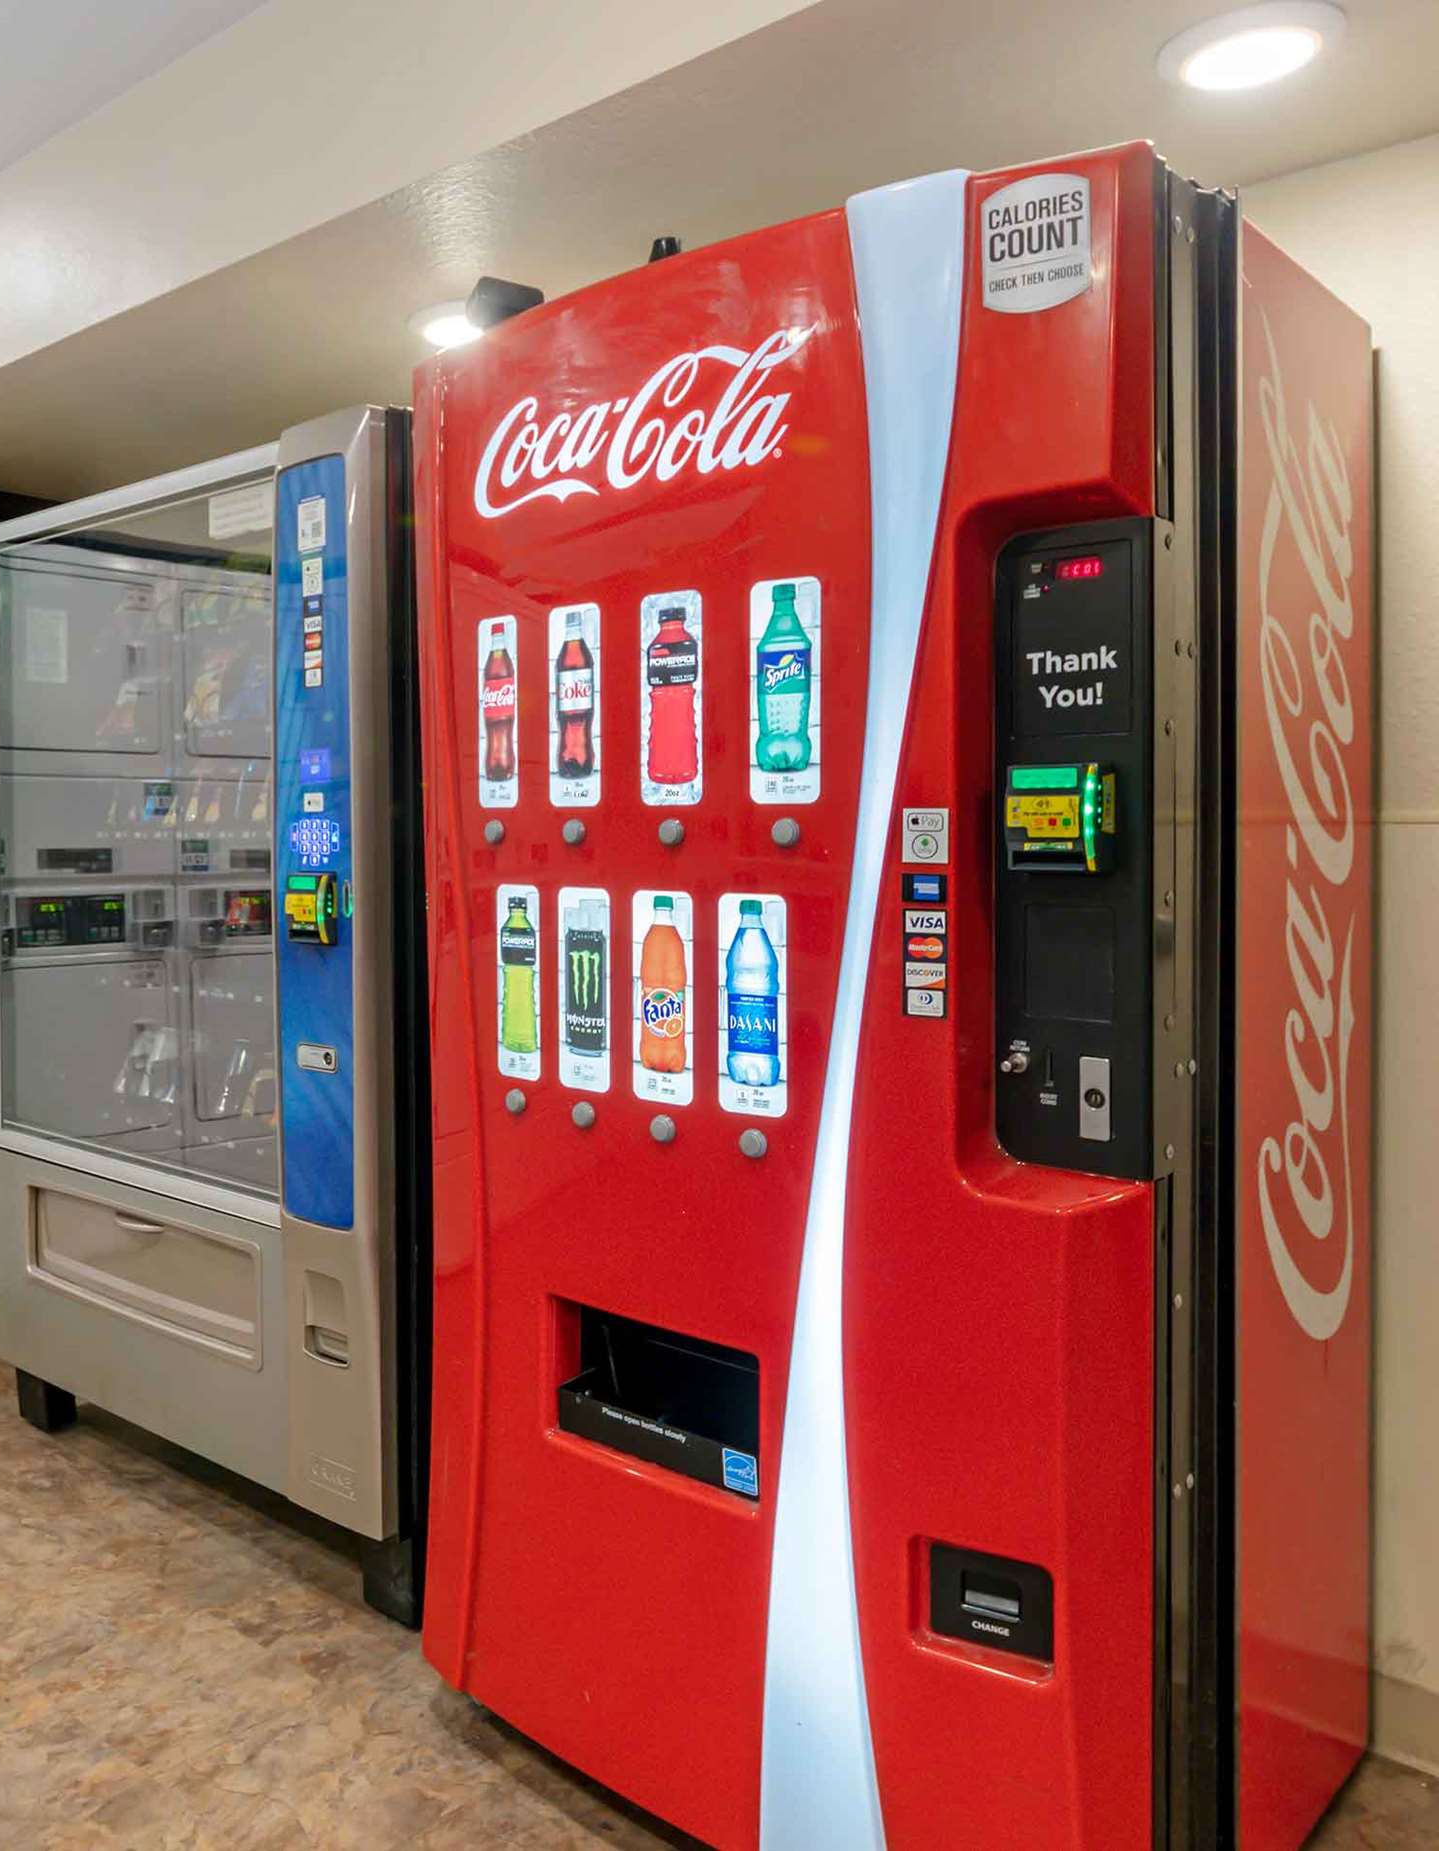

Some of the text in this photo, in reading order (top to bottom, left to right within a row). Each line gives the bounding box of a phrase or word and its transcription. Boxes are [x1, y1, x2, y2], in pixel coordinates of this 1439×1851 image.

[988, 190, 1083, 230] CALORIES
[989, 215, 1084, 263] COUNT
[989, 263, 1084, 293] CHECK THEN CHOOSE
[474, 321, 819, 518] Coca-Cola
[1026, 646, 1118, 675] Thank
[765, 662, 802, 688] Sprite
[1038, 682, 1104, 708] You!
[921, 815, 940, 828] Pay
[1258, 303, 1355, 1342] Coca-Cola
[910, 916, 944, 929] VISA
[906, 967, 944, 977] DISCOVER
[730, 1014, 776, 1033] DASANI
[602, 1406, 623, 1420] Please
[971, 1620, 1011, 1637] CHANGE
